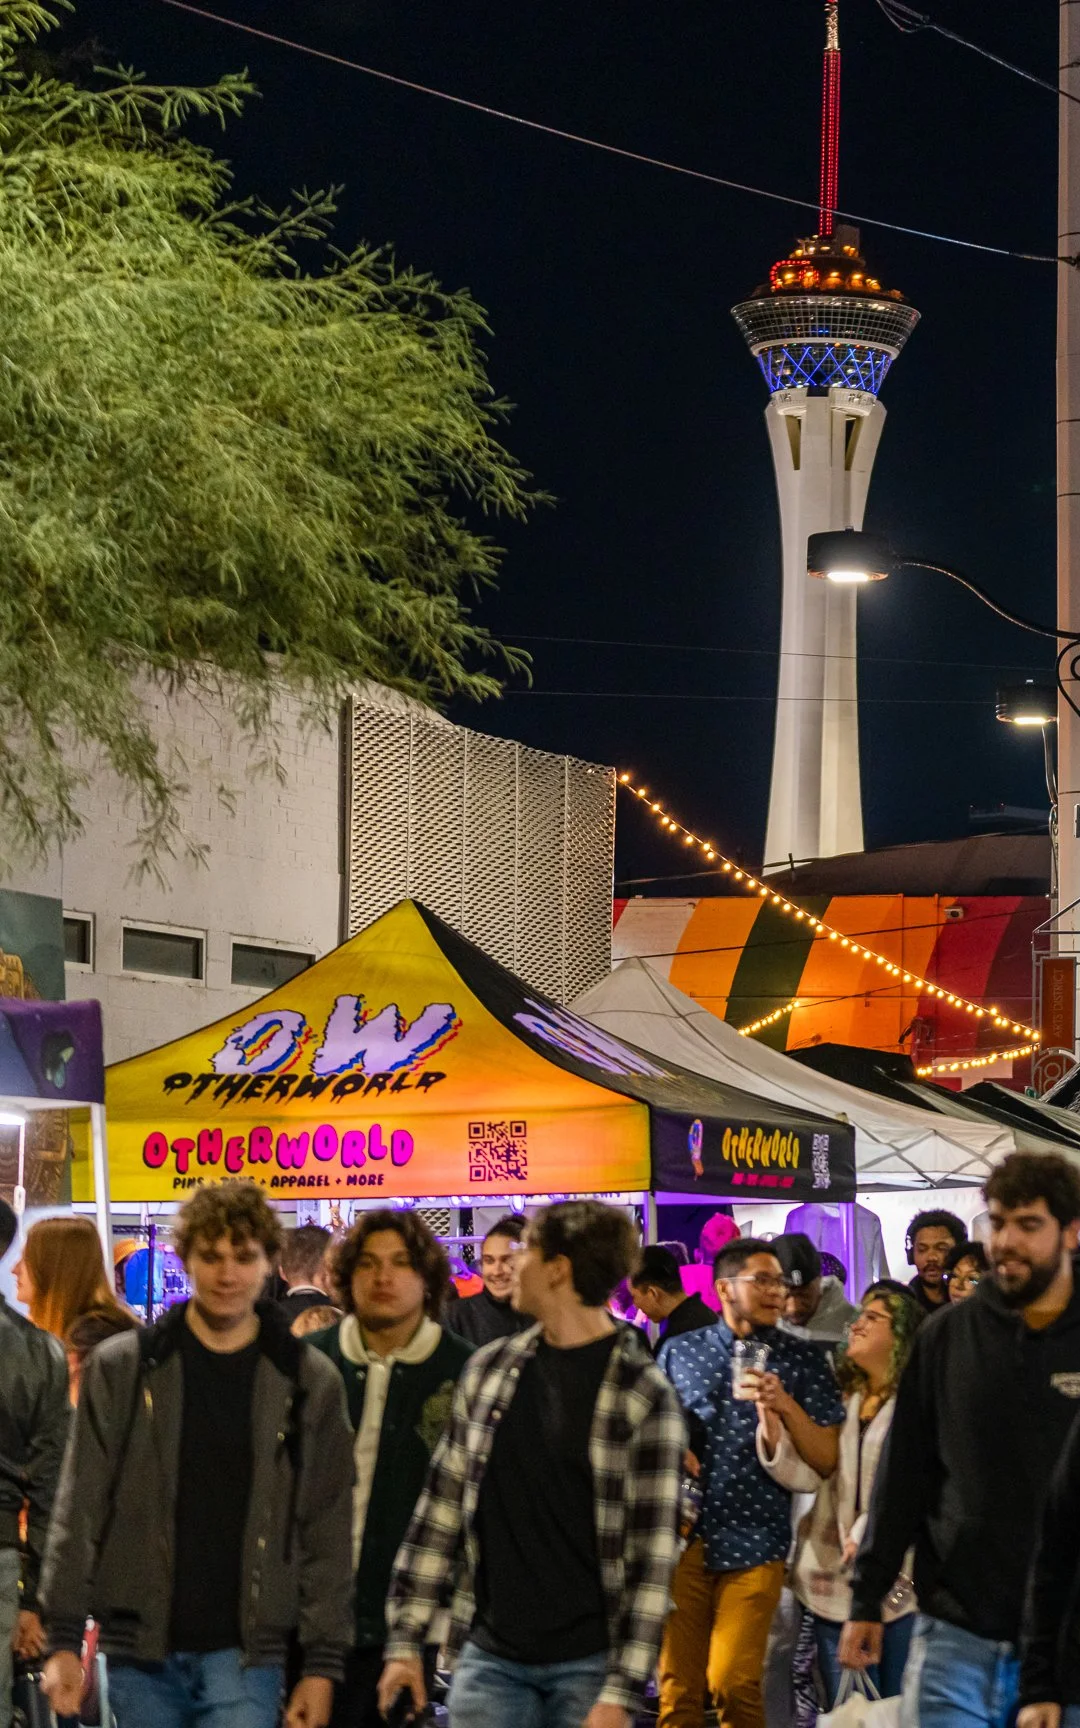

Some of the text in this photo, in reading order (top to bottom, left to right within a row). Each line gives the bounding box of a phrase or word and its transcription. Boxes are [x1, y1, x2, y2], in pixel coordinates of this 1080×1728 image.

[1052, 969, 1065, 1038] ARTS DISTRICT
[209, 993, 460, 1077] OW
[163, 1072, 446, 1108] OTHERWORLD
[143, 1124, 414, 1174] OTHERWORLD
[722, 1127, 799, 1168] OTHERWORLD
[270, 1174, 330, 1188] APPAREL
[346, 1174, 384, 1187] MORE
